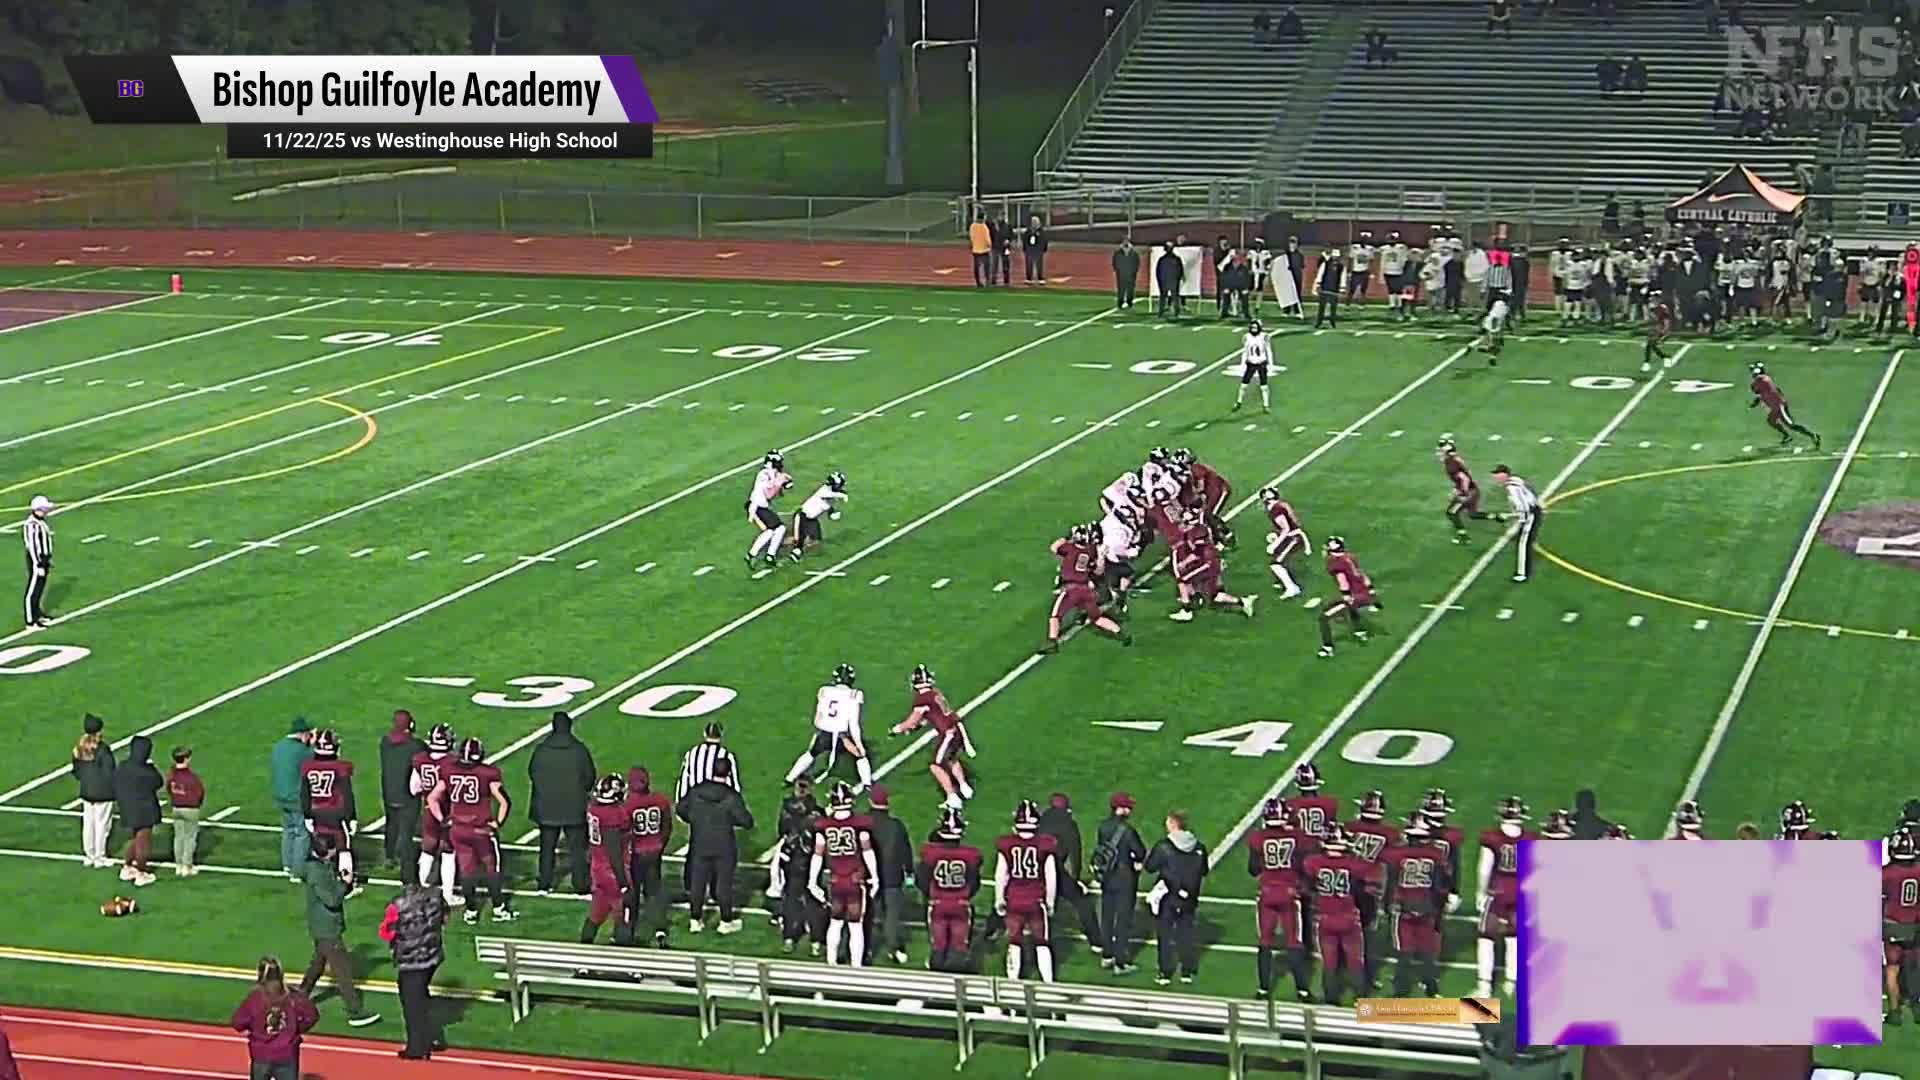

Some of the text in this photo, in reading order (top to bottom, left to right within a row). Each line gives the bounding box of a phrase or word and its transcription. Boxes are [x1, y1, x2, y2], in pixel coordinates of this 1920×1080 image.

[1677, 208, 1778, 224] CENTRAL CATHOLIC
[471, 675, 738, 718] 30
[828, 700, 839, 717] 5
[1182, 720, 1455, 767] 40
[307, 770, 335, 797] 27
[450, 775, 479, 804] 73
[1298, 807, 1325, 836] 12
[825, 826, 857, 856] 23
[1263, 837, 1296, 869] 87
[1352, 832, 1386, 862] 47
[933, 859, 967, 888] 42
[1010, 846, 1039, 878] 14
[1317, 867, 1350, 897] 34
